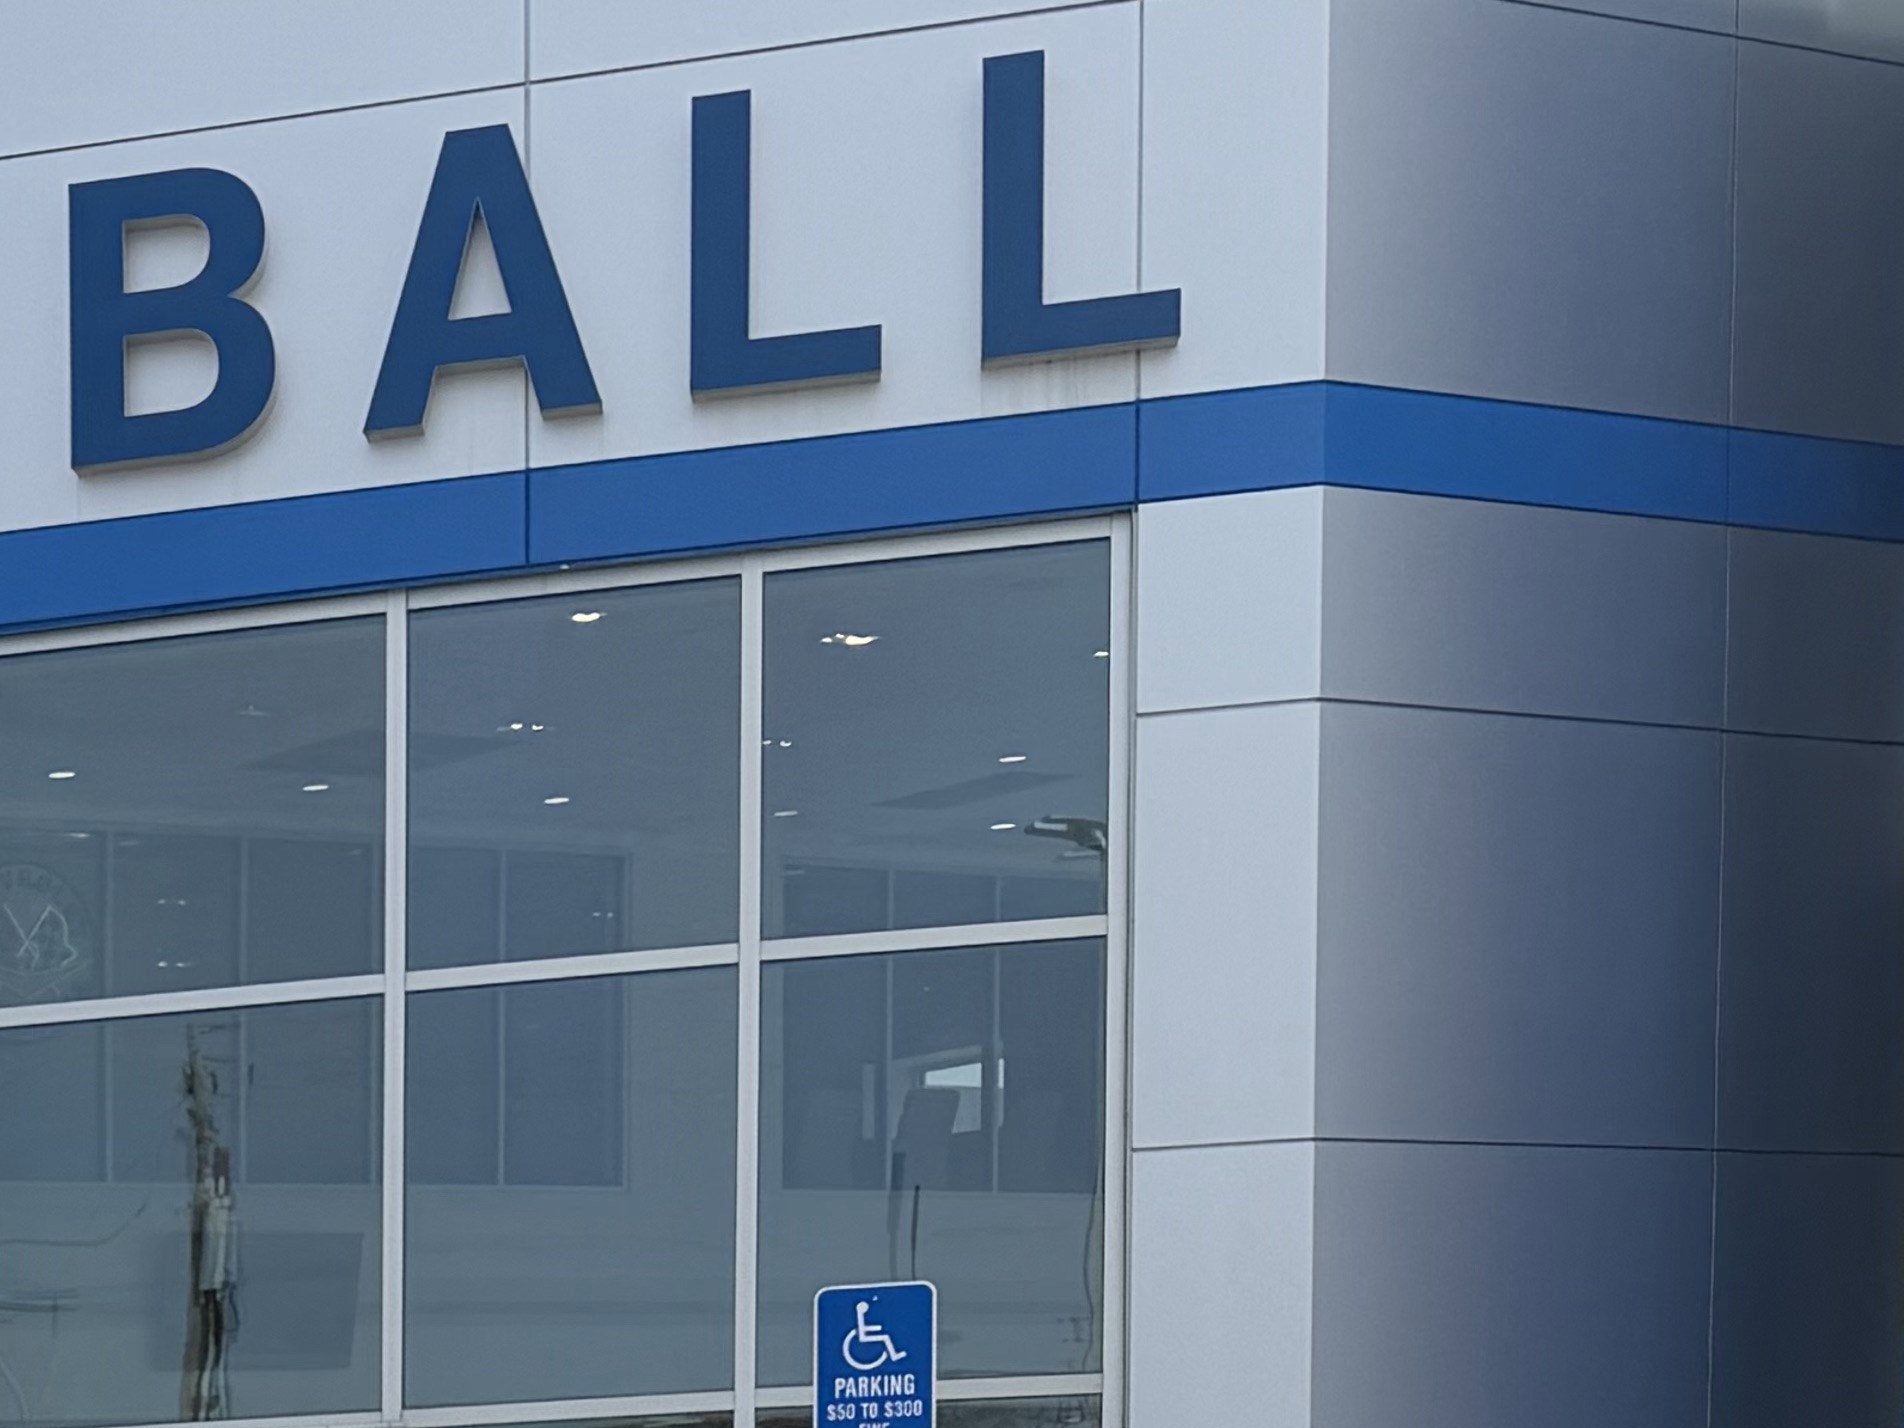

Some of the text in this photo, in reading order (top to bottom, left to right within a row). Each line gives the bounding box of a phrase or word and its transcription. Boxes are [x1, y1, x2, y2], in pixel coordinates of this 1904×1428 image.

[69, 53, 1180, 472] BALL
[834, 1374, 915, 1398] PARKING
[827, 1400, 923, 1421] $50 TO $300
